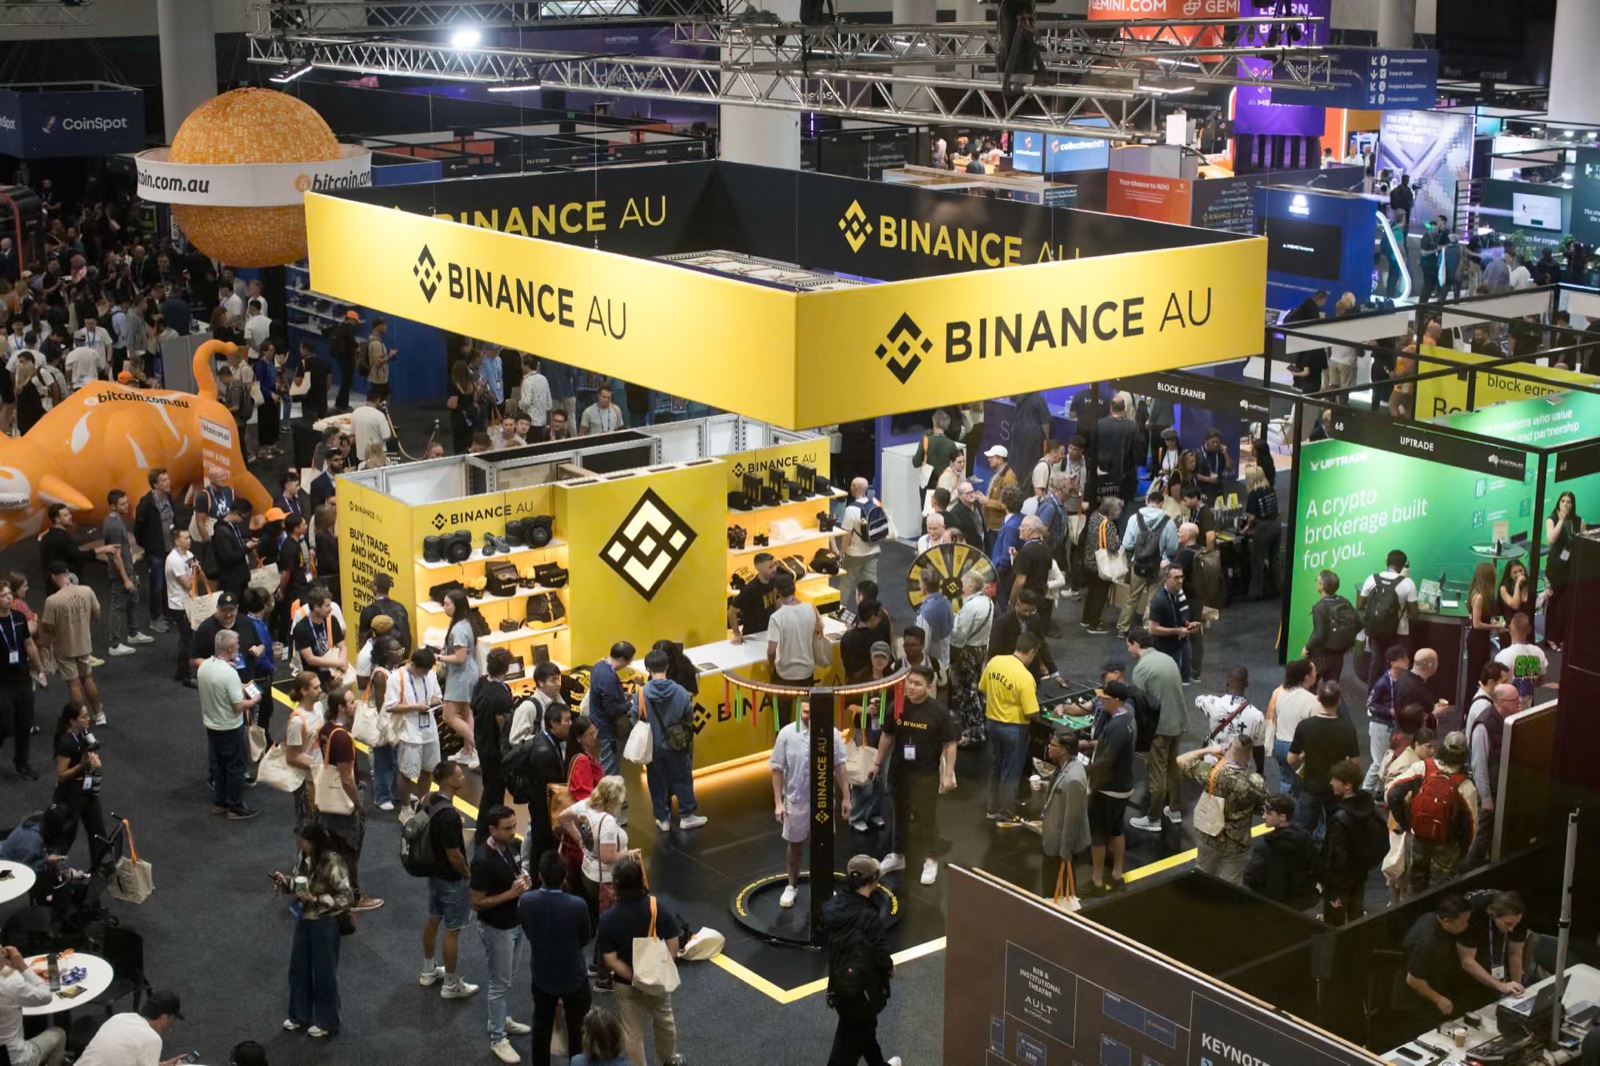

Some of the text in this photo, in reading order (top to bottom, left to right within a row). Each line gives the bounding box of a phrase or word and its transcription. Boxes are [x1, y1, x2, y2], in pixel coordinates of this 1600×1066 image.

[62, 117, 128, 131] CoinSpot
[432, 195, 666, 237] NANCE AU
[879, 214, 1023, 268] BINANCE
[447, 262, 627, 340] BINANCE AU
[945, 286, 1212, 365] BINANCE AU
[1157, 382, 1206, 401] BLOCK EARNER
[1487, 373, 1521, 393] block
[97, 390, 189, 409] bitcoin.com.au
[1551, 409, 1573, 422] value
[1400, 436, 1434, 452] UPTRADE
[748, 452, 817, 474] BINANCE AU
[354, 504, 376, 520] BINANCE
[450, 501, 534, 525] BINANCE AU
[1305, 488, 1377, 519] A crypto
[1304, 497, 1428, 545] brokerage built
[349, 527, 391, 557] BUY, TRADE,
[350, 543, 398, 575] AND HOLD ON
[1303, 540, 1365, 571] for you.
[817, 737, 828, 809] BINANCE AU
[1019, 968, 1062, 995] INSTITUTIONAL
[1032, 966, 1044, 978] B2B
[1028, 981, 1052, 999] THEATRE
